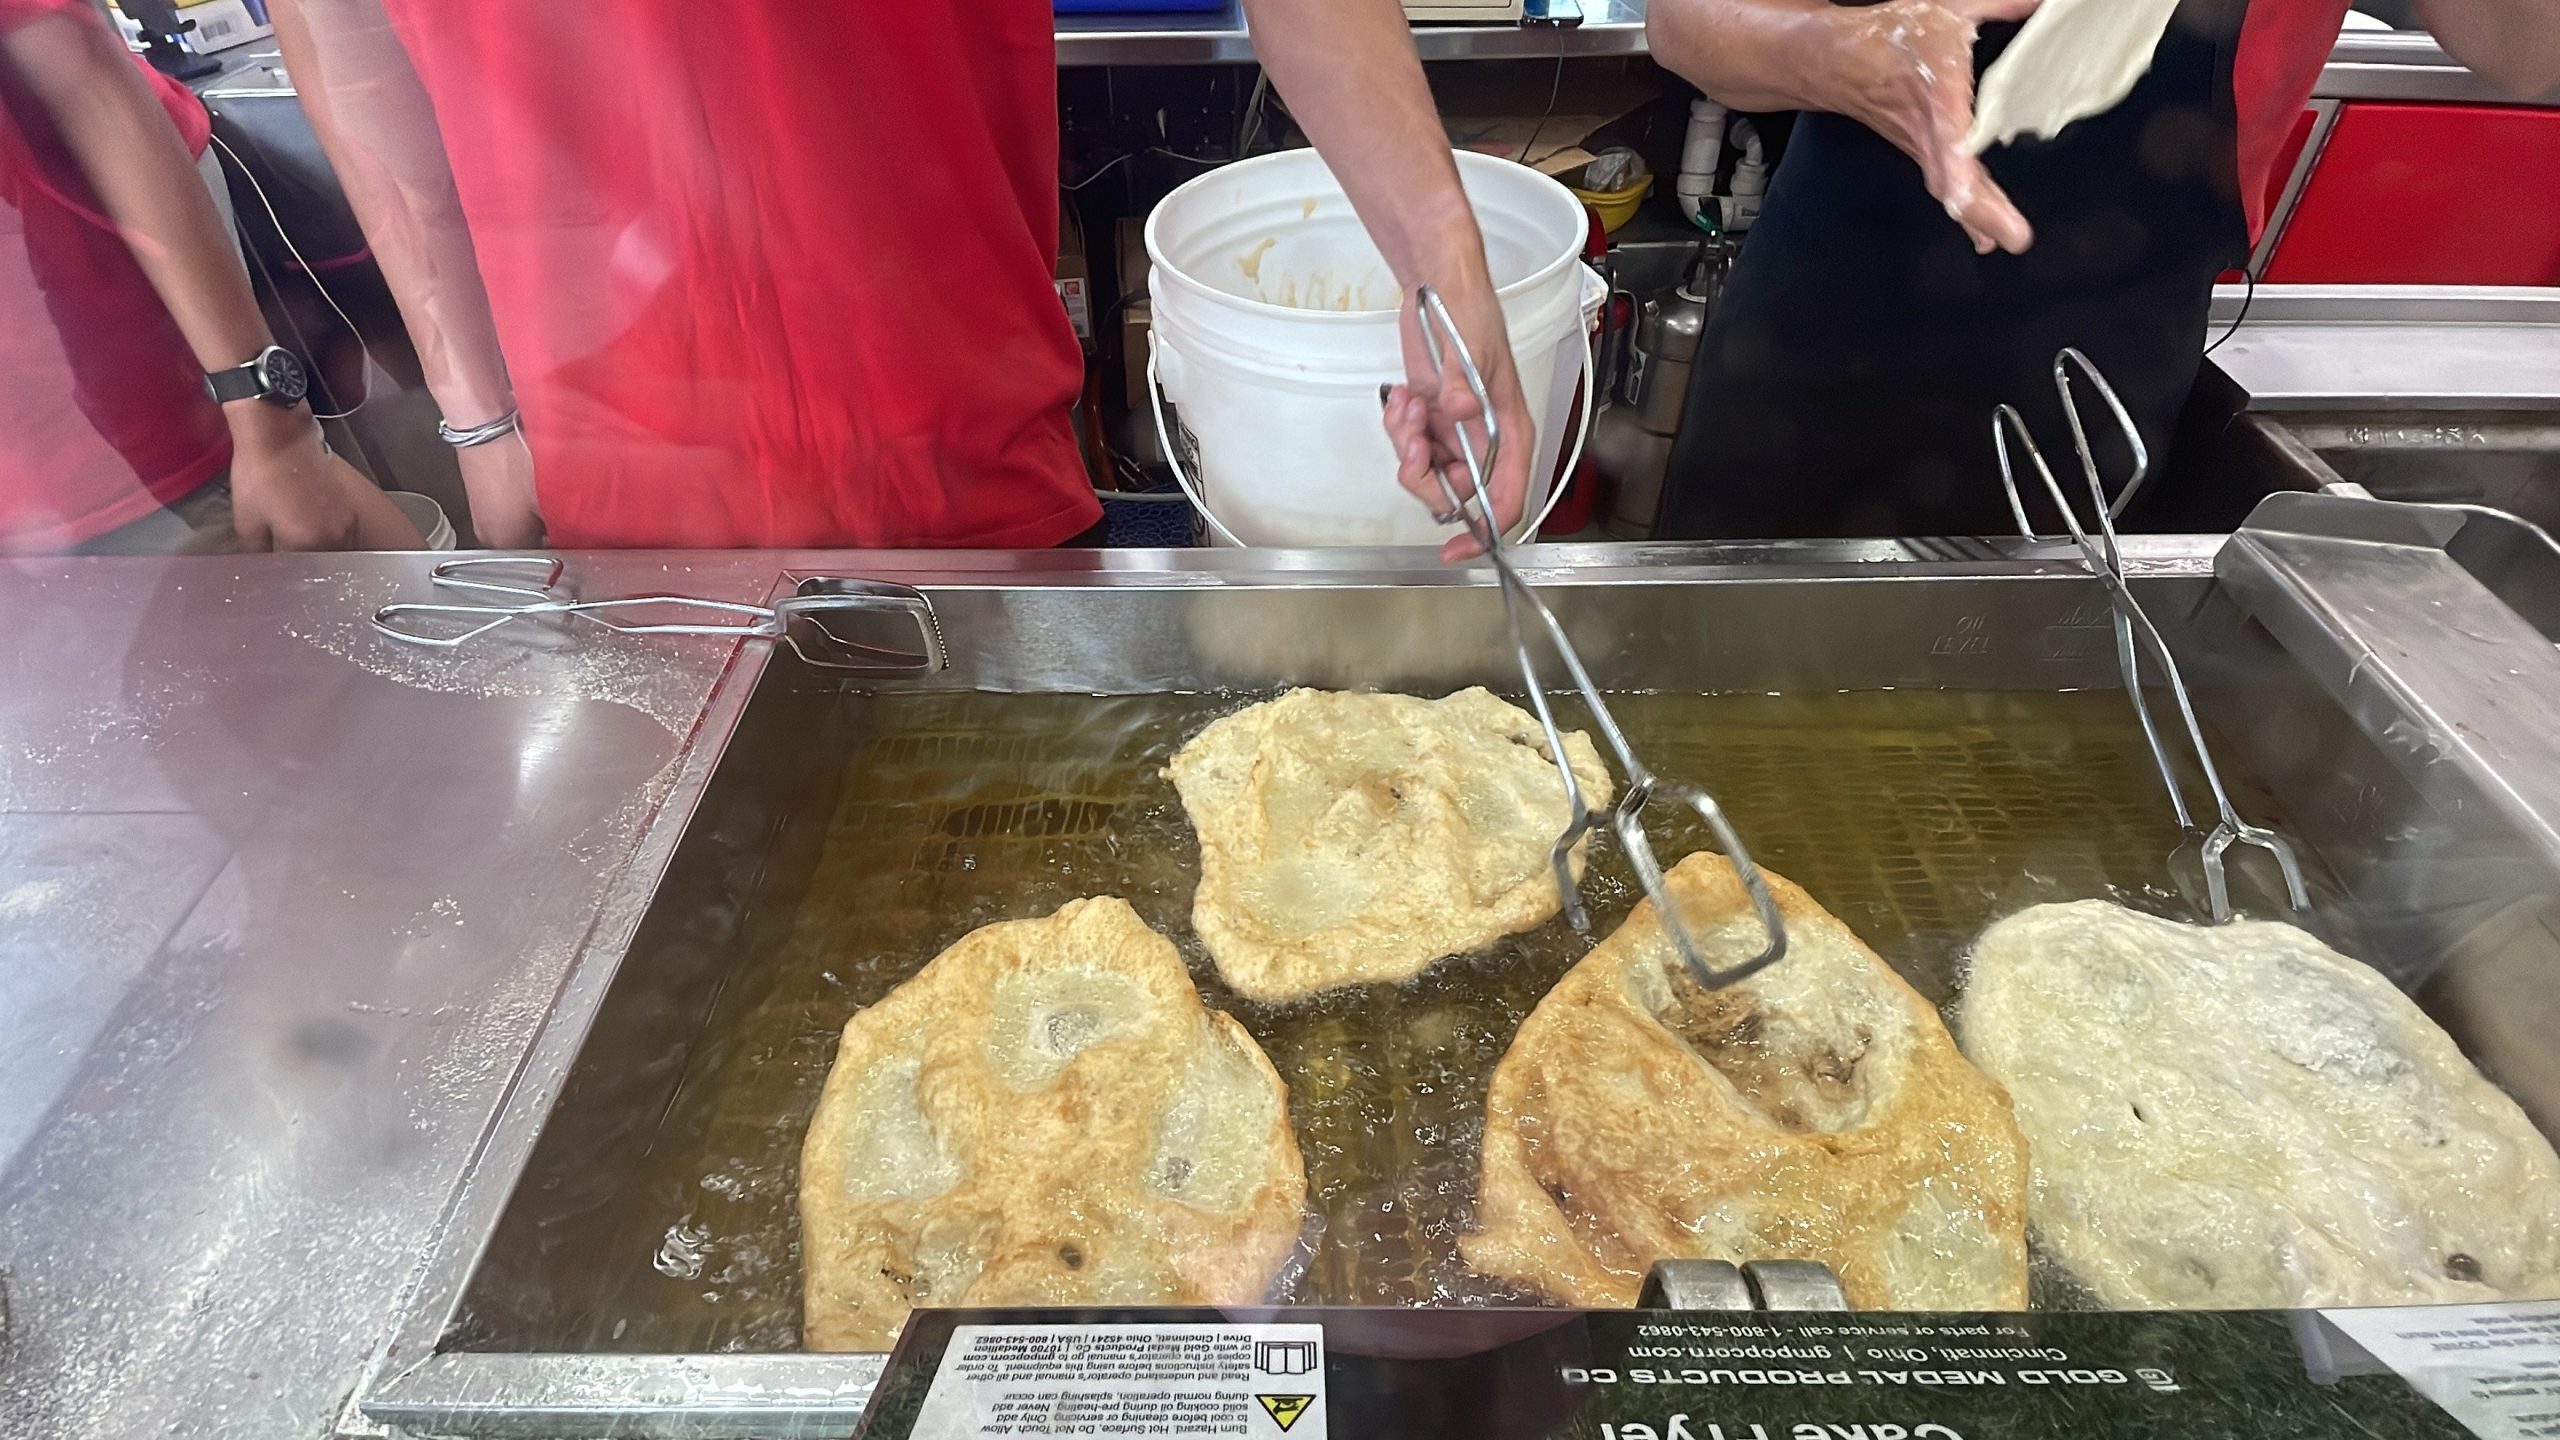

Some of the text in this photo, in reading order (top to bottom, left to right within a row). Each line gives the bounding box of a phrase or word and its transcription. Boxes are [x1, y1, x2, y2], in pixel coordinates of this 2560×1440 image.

[1636, 1325, 1782, 1337] 1-800-543-0862
[1799, 1327, 1834, 1338] call
[1838, 1325, 1909, 1338] service
[1914, 1327, 1935, 1335] or
[1938, 1324, 1990, 1337] parts
[1995, 1326, 2030, 1338] For
[1058, 1335, 1081, 1343] USA
[1090, 1335, 1124, 1343] 45241
[1155, 1334, 1214, 1342] Cincinnati,
[973, 1345, 1028, 1353] Medallion
[1094, 1344, 1145, 1352] Products
[1148, 1344, 1180, 1352] Medal
[1183, 1344, 1210, 1352] Gold
[1213, 1344, 1238, 1352] write
[1628, 1345, 1831, 1359] gmpopcorn.com
[962, 1352, 1055, 1361] gmpopcorn.com
[1071, 1352, 1085, 1361] go
[1129, 1353, 1181, 1361] operator's
[1217, 1353, 1251, 1361] copies
[1867, 1348, 1928, 1361] Ohio
[1931, 1347, 2068, 1361] Cincinnati,
[987, 1363, 999, 1371] To
[1064, 1363, 1084, 1371] this
[1086, 1362, 1115, 1371] using
[1118, 1363, 1152, 1371] before
[1155, 1363, 1215, 1371] instructions
[1218, 1362, 1250, 1371] safety
[965, 1372, 1250, 1381] Read and understand operator's manual and all other
[1629, 1369, 1853, 1385] PRODUCTS
[1858, 1370, 2006, 1384] MEDAL
[2016, 1369, 2128, 1384] GOLD
[1060, 1392, 1113, 1401] splashing
[1117, 1392, 1171, 1401] operation,
[1174, 1393, 1212, 1401] normal
[1214, 1391, 1249, 1401] during
[991, 1403, 1013, 1412] add
[1016, 1403, 1051, 1412] Never
[1122, 1402, 1158, 1412] during
[1160, 1403, 1173, 1412] oil
[1176, 1402, 1219, 1412] cooking
[1223, 1403, 1249, 1412] solid
[995, 1414, 1018, 1423] add
[1021, 1413, 1047, 1423] Only
[1121, 1413, 1169, 1422] cleaning
[1172, 1414, 1208, 1423] before
[1210, 1414, 1234, 1423] cool
[1237, 1414, 1248, 1423] to
[980, 1425, 1013, 1434] Allow
[1054, 1425, 1075, 1434] Not
[1078, 1425, 1095, 1434] Do
[1149, 1425, 1169, 1434] Hot
